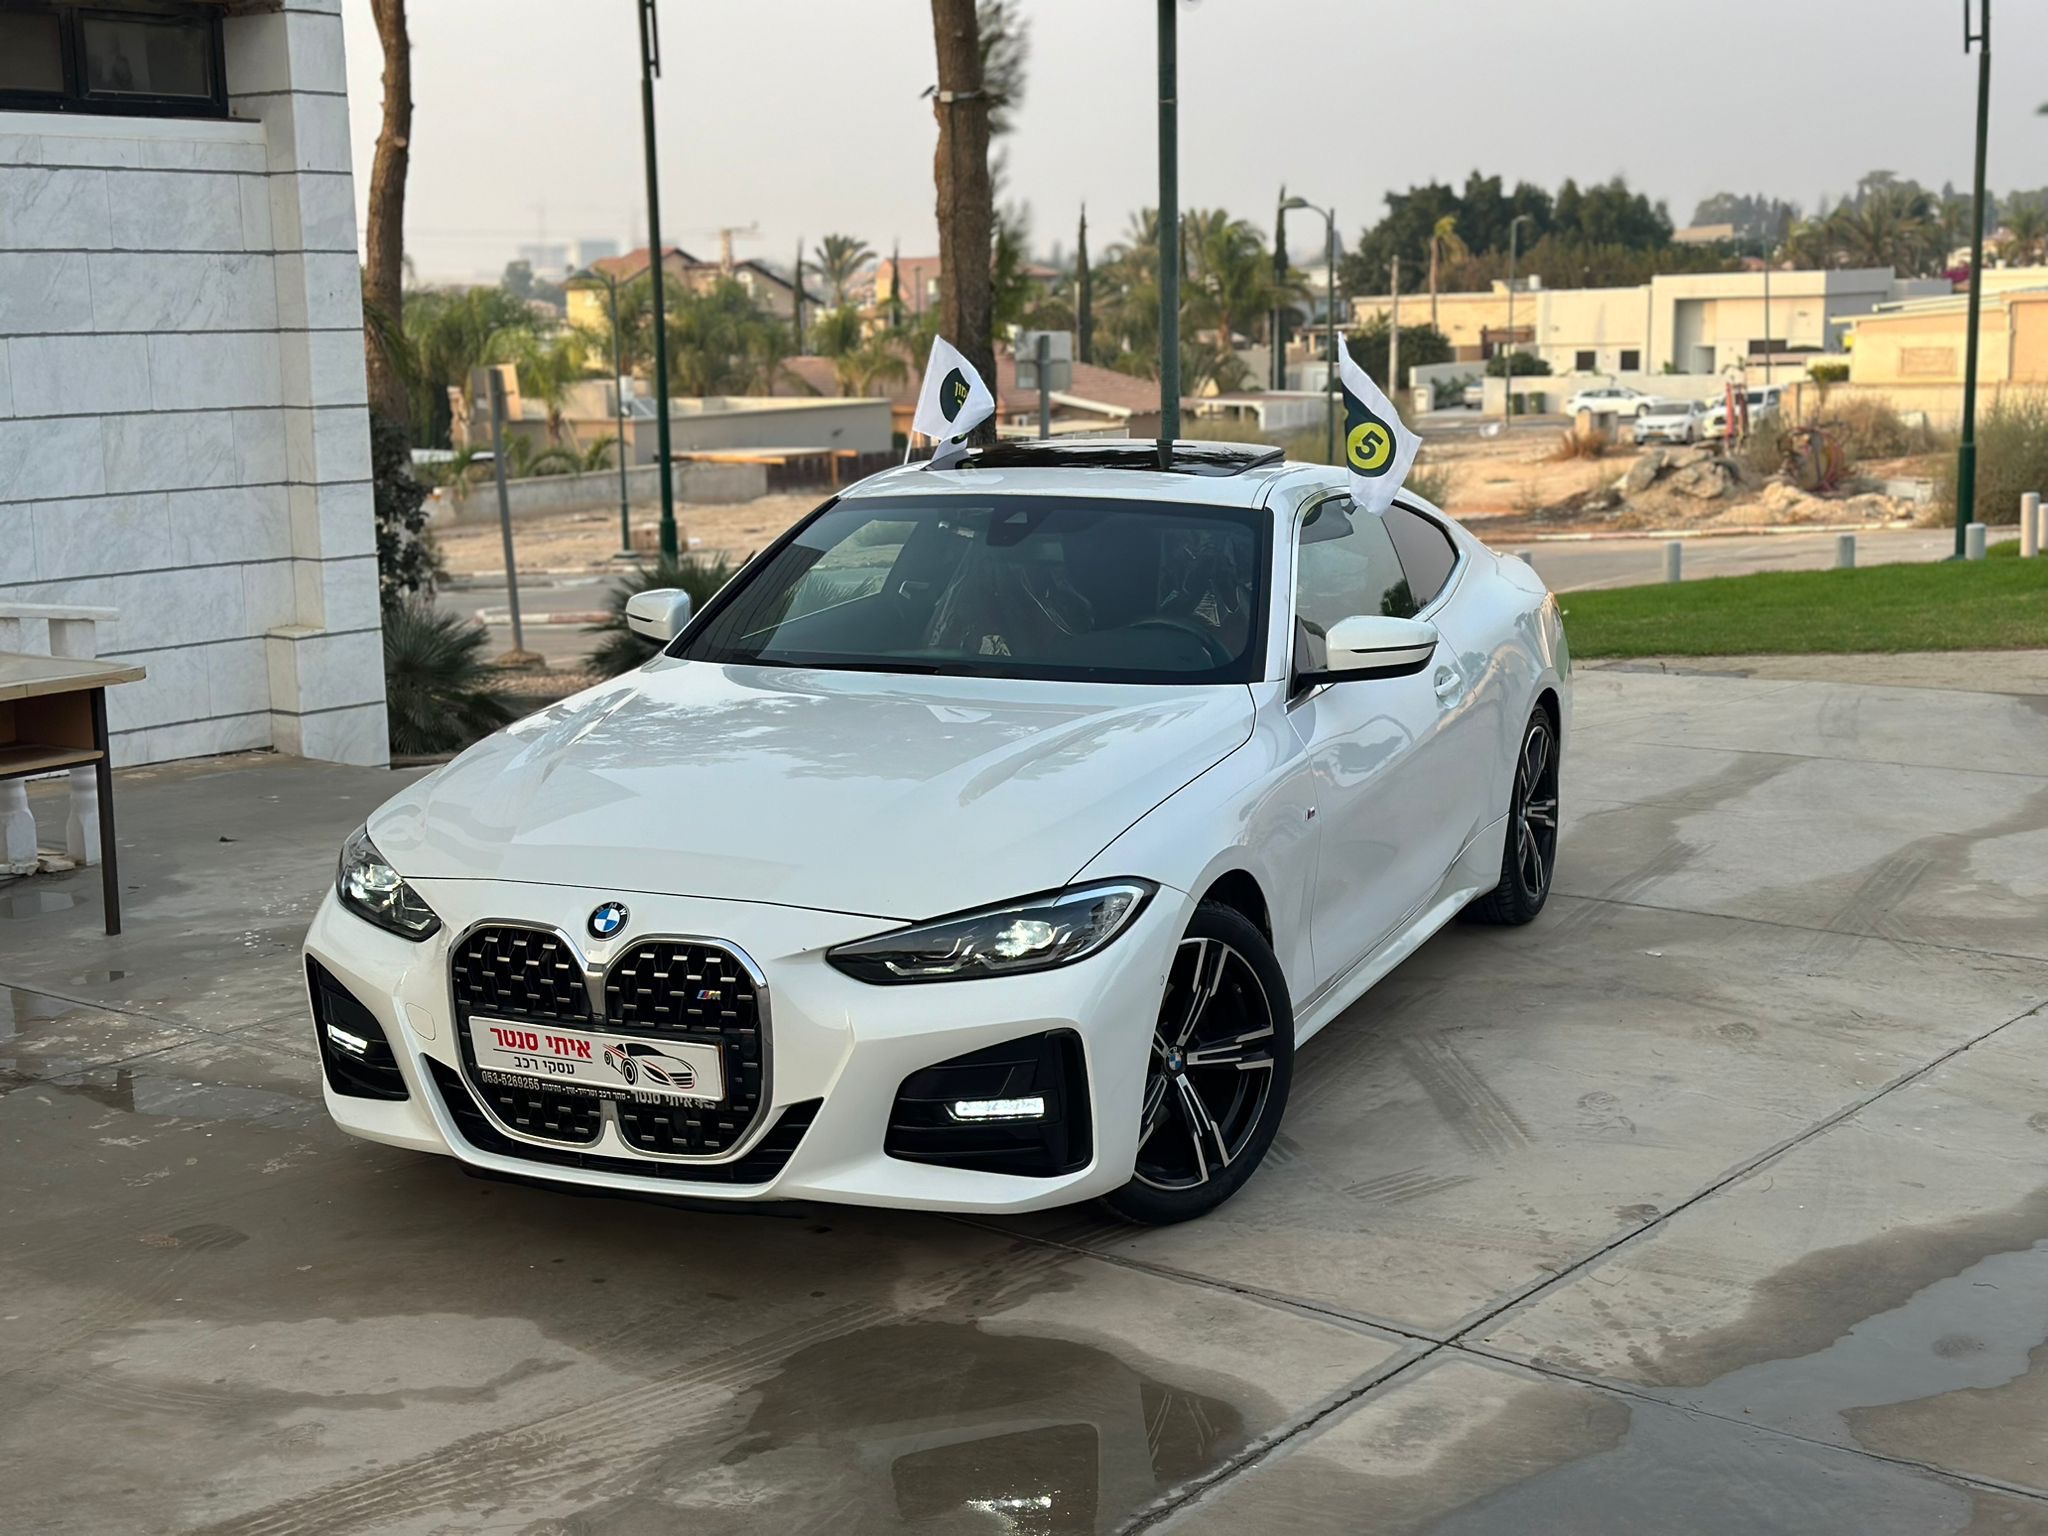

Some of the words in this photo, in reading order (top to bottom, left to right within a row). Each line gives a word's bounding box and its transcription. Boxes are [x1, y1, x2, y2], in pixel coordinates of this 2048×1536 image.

[1355, 430, 1383, 460] 5
[490, 1027, 539, 1051] סנטר
[545, 1035, 592, 1059] איתי
[514, 1056, 539, 1070] רכב
[543, 1060, 575, 1075] עסקי
[482, 1071, 540, 1091] 053-5269255
